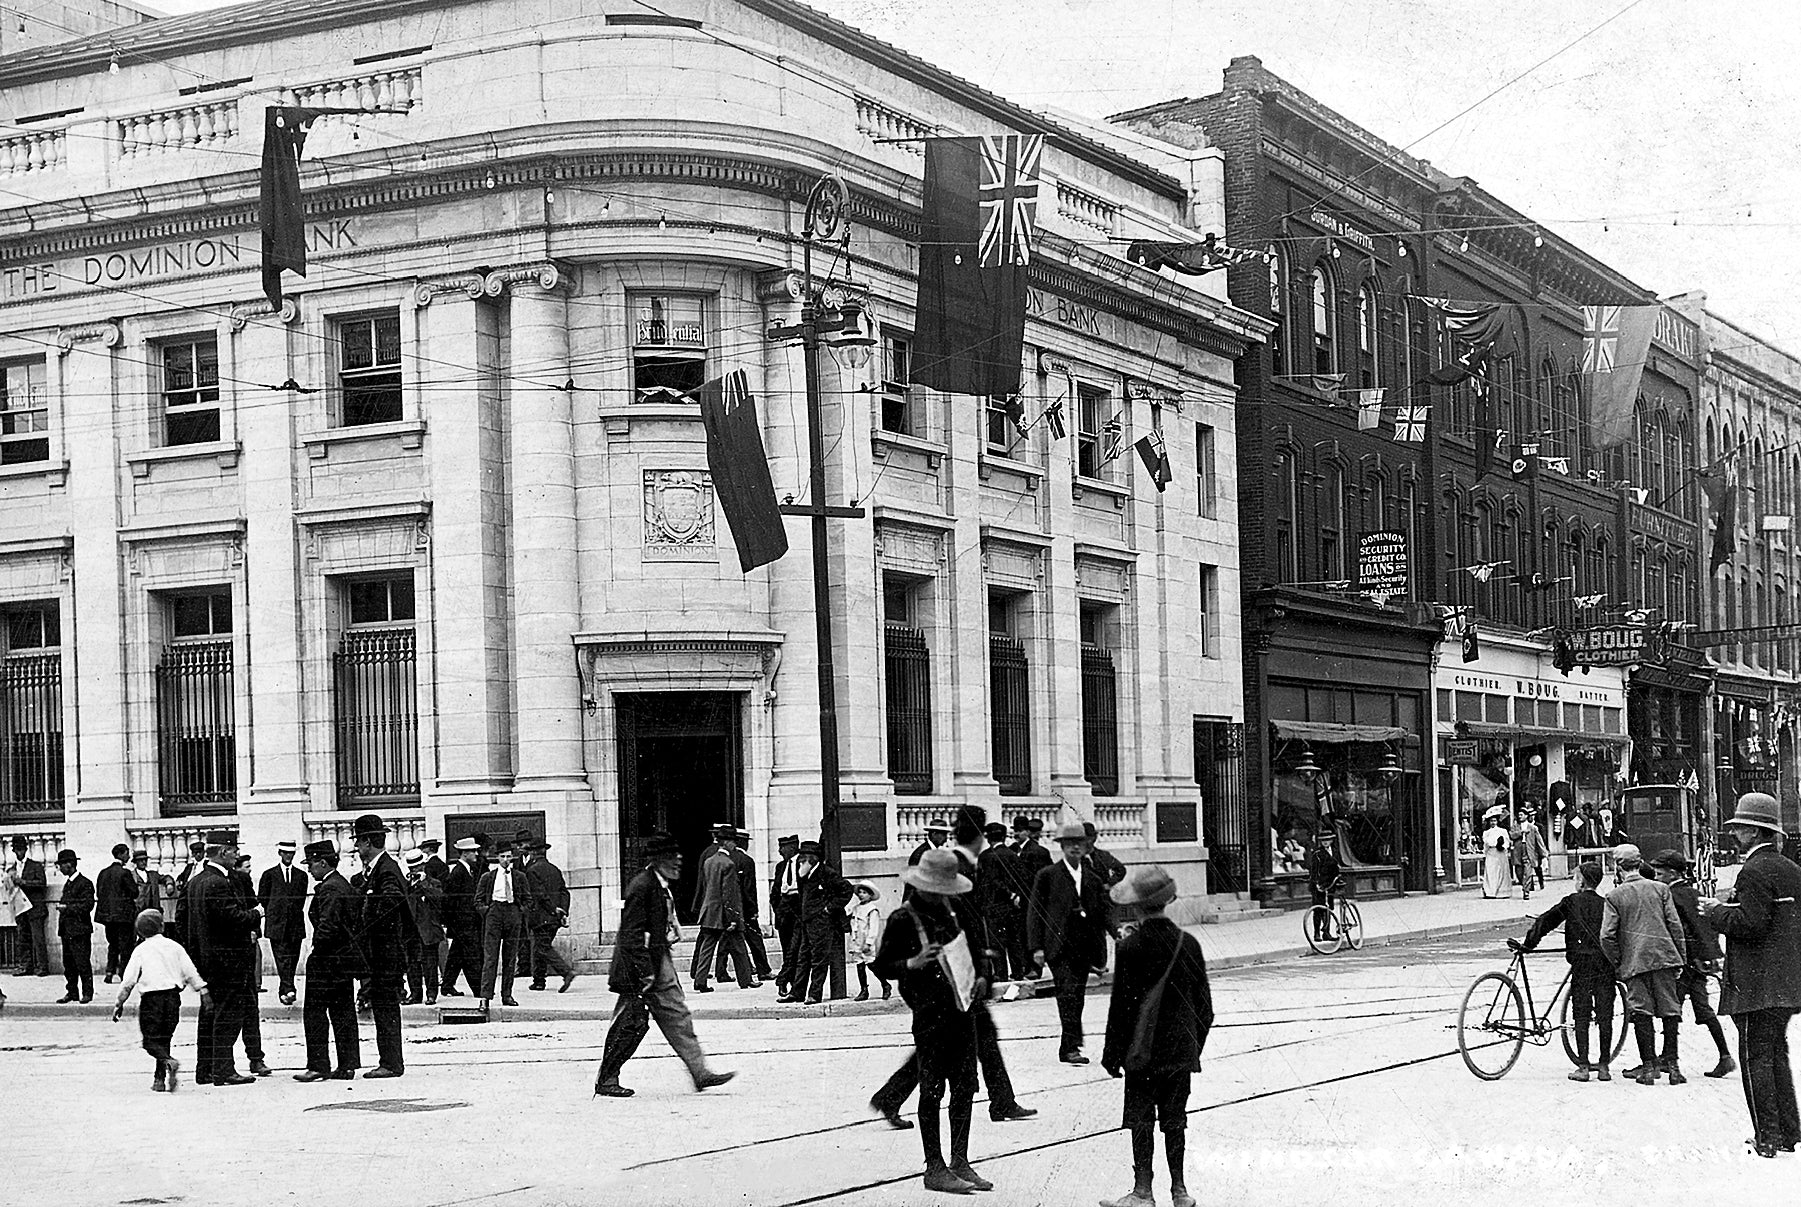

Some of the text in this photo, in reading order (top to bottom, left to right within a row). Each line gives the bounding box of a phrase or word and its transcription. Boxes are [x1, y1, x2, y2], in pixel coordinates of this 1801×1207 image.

[4, 219, 358, 297] THE DOMINION NK
[1058, 298, 1101, 335] BANK
[1361, 533, 1405, 545] DOMINION
[653, 546, 709, 555] DOMINION
[1360, 544, 1406, 555] SECURITY
[1367, 554, 1395, 563] CREDIT
[1360, 563, 1394, 576] LOANS
[1381, 574, 1407, 586] Security
[1576, 649, 1640, 662] CLOTHIER
[1528, 682, 1560, 698] BOUG.
[1740, 771, 1777, 780] DRUGS
